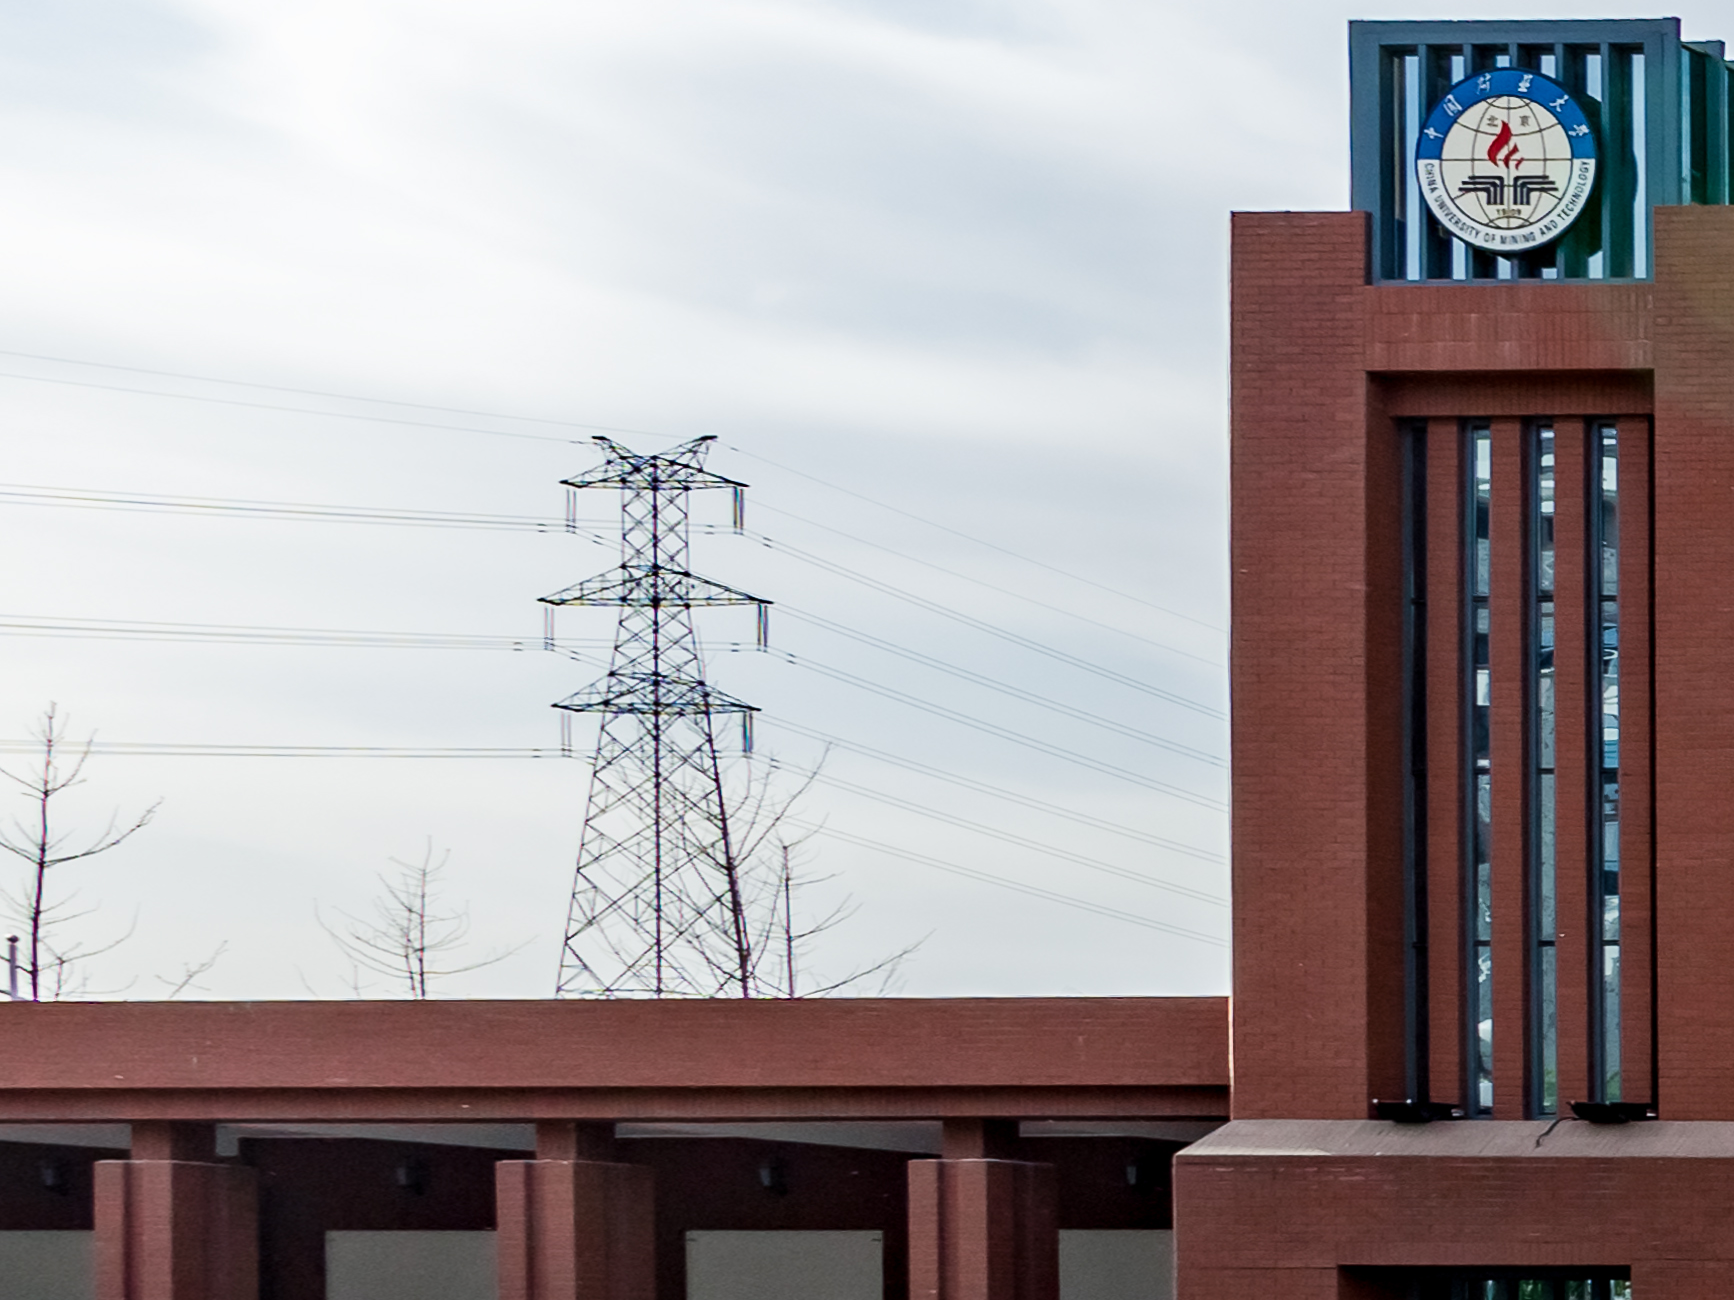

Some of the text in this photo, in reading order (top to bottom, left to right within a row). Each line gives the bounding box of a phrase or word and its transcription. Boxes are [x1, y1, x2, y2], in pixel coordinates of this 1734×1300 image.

[1433, 194, 1481, 241] UNIVERSITY
[1483, 231, 1497, 244] OF
[1499, 230, 1537, 246] MINING
[1539, 218, 1559, 237] AND
[1556, 160, 1591, 221] TECHNOLOGY
